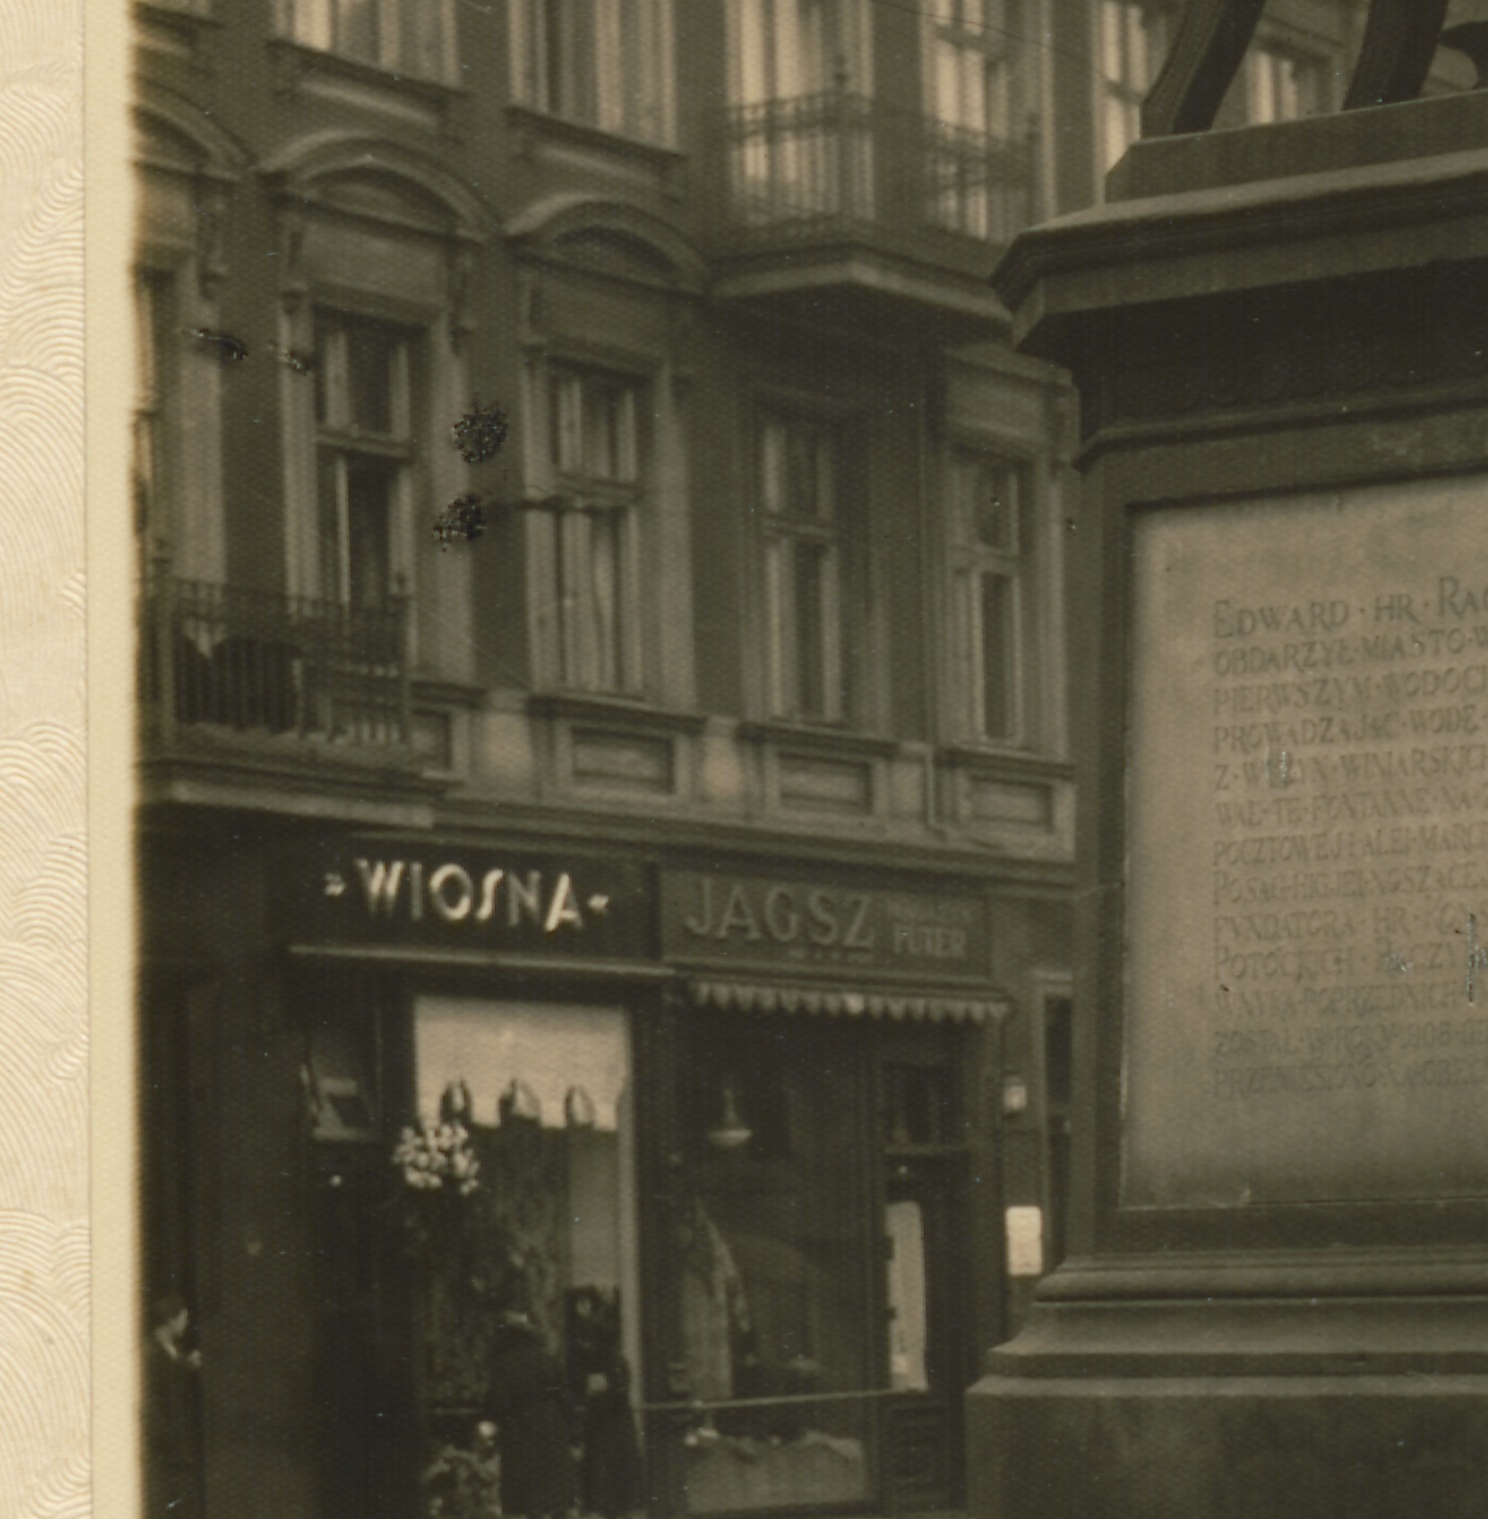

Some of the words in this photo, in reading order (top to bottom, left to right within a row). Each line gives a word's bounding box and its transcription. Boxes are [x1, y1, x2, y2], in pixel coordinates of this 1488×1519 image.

[1213, 598, 1351, 640] EDWARD
[1362, 627, 1465, 663] MIASTO
[1212, 674, 1372, 716] PIERWSZYM
[685, 877, 877, 949] JAGSZ
